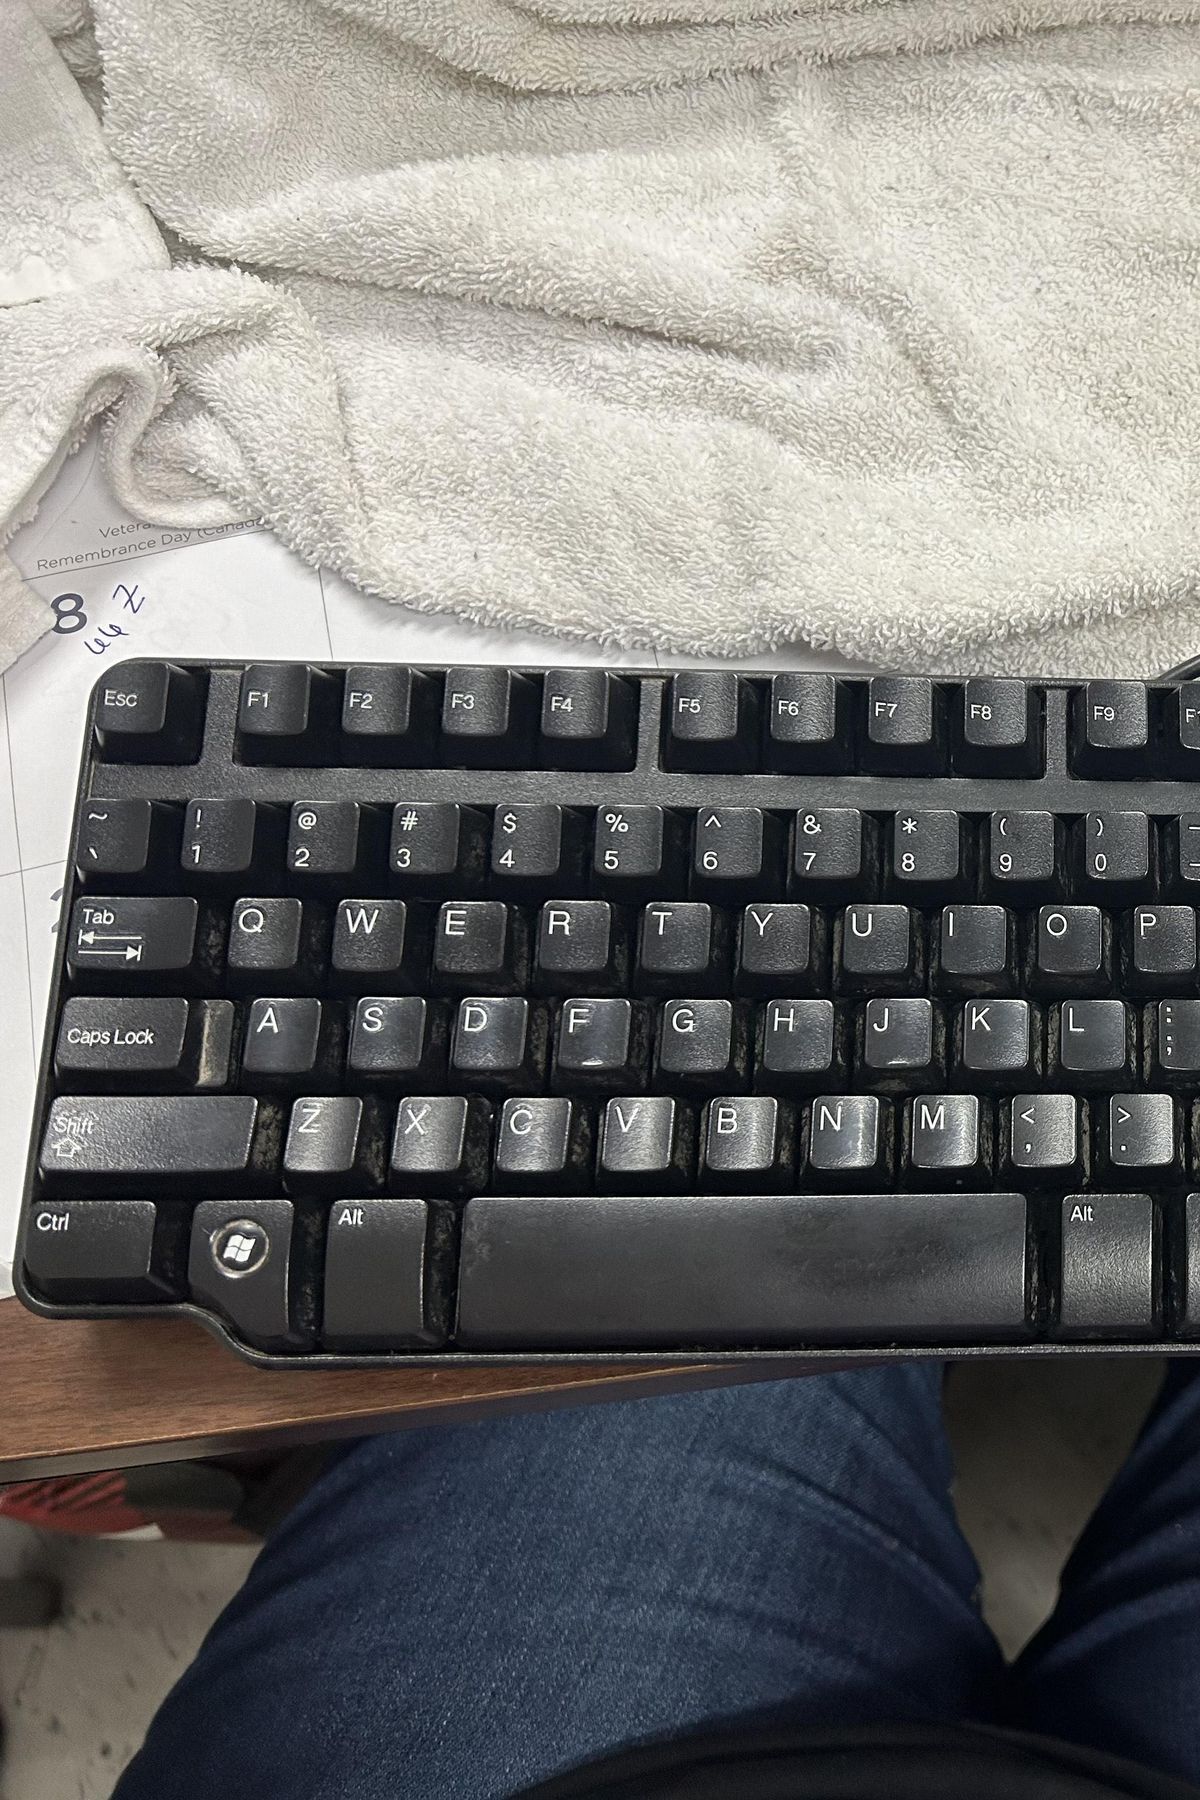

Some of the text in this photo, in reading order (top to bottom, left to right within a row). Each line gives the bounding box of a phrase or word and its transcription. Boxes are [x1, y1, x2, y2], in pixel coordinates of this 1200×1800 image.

[99, 521, 155, 539] Vetera
[37, 536, 157, 571] Remembrance
[161, 529, 192, 546] Day
[50, 592, 88, 634] 8
[104, 689, 138, 707] Esc
[247, 691, 269, 708] F1
[349, 692, 373, 709] F2
[451, 693, 475, 710] F3
[551, 696, 574, 713] F4
[678, 697, 701, 714] F5
[778, 700, 799, 716] F6
[875, 701, 898, 718] F7
[970, 704, 992, 720] F8
[1094, 705, 1115, 721] F9
[195, 808, 203, 829] !
[298, 811, 317, 830] @
[400, 810, 419, 831] #
[502, 812, 517, 834] $
[605, 813, 629, 833] %
[803, 814, 822, 835] &
[999, 817, 1008, 837] (
[1095, 817, 1105, 838] )
[191, 844, 201, 864] 1
[294, 847, 310, 867] 2
[396, 848, 411, 868] 3
[499, 848, 516, 868] 4
[604, 850, 619, 870] 5
[703, 851, 718, 870] 6
[803, 852, 817, 871] 7
[901, 852, 915, 872] 8
[999, 853, 1012, 872] 9
[1095, 853, 1107, 872] 0
[82, 908, 115, 925] Tab
[238, 908, 264, 933] Q
[346, 908, 379, 934] W
[445, 909, 467, 936] E
[548, 910, 571, 936] R
[651, 911, 673, 936] T
[751, 911, 774, 936] Y
[852, 912, 873, 937] U
[948, 911, 955, 938] I
[1046, 913, 1068, 937] O
[1140, 913, 1157, 936] P
[256, 1007, 279, 1034] A
[362, 1006, 384, 1032] S
[464, 1006, 490, 1032] D
[568, 1008, 590, 1033] F
[672, 1008, 699, 1033] G
[773, 1007, 795, 1032] H
[872, 1007, 889, 1032] J
[971, 1006, 991, 1031] K
[1069, 1007, 1085, 1033] L
[67, 1027, 154, 1047] Caps Lock
[53, 1114, 95, 1137] Shift
[298, 1108, 321, 1134] Z
[404, 1107, 429, 1135] X
[509, 1109, 533, 1135] C
[615, 1106, 641, 1133] V
[717, 1107, 741, 1134] B
[819, 1105, 842, 1132] N
[921, 1104, 946, 1130] M
[1021, 1107, 1035, 1124] <
[1117, 1107, 1131, 1123] >
[36, 1212, 70, 1231] Ctrl
[338, 1208, 364, 1225] Alt
[1070, 1205, 1094, 1222] Alt
